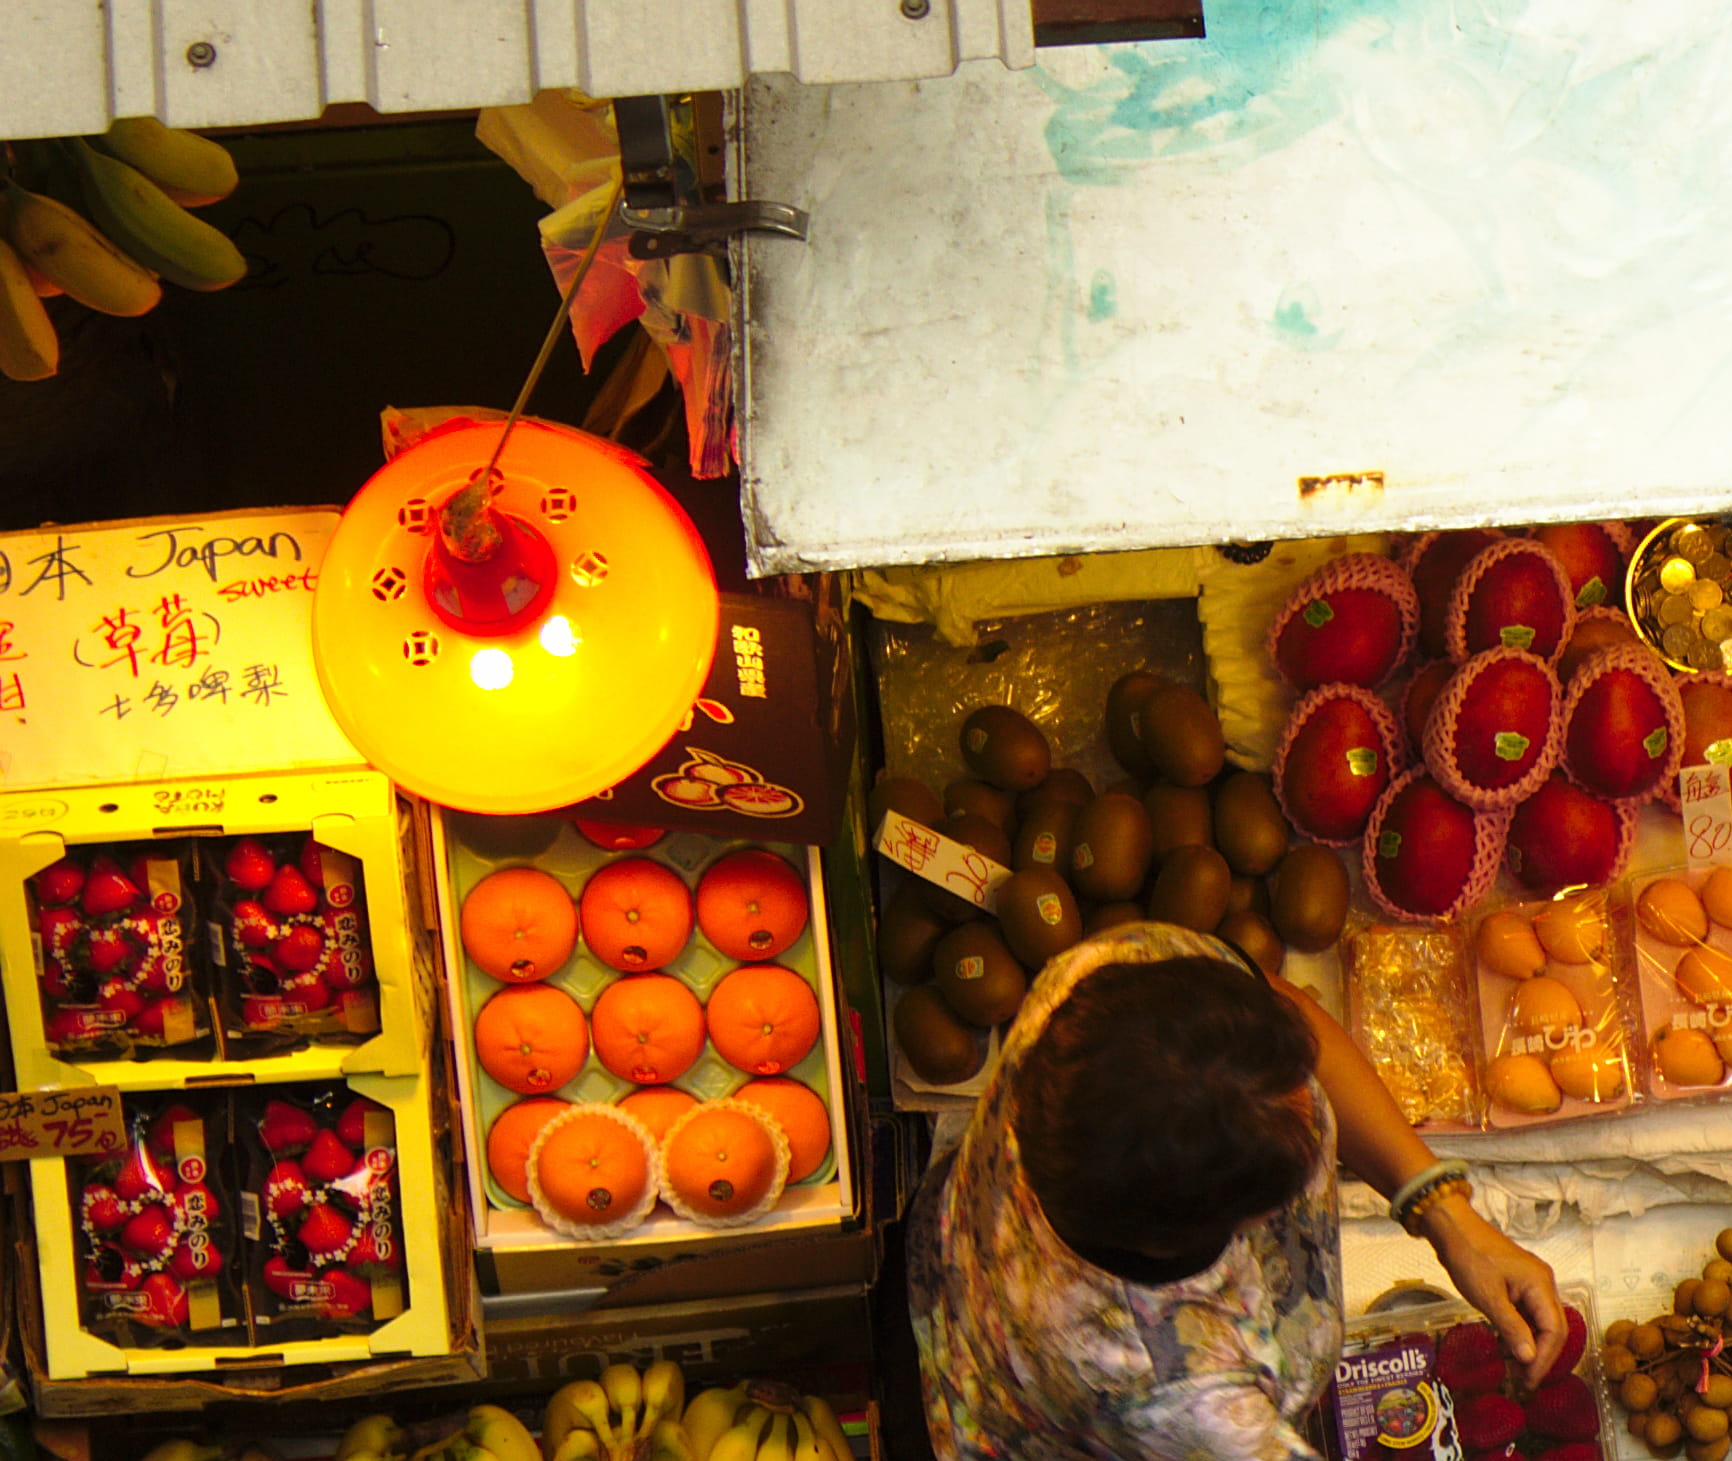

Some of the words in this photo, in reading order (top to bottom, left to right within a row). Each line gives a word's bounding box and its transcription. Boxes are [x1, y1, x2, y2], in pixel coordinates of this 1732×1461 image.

[126, 526, 302, 582] Japan
[216, 567, 318, 602] sweet
[1690, 814, 1732, 859] 80
[41, 1093, 113, 1119] Japan
[1335, 1348, 1428, 1383] Driscoll's
